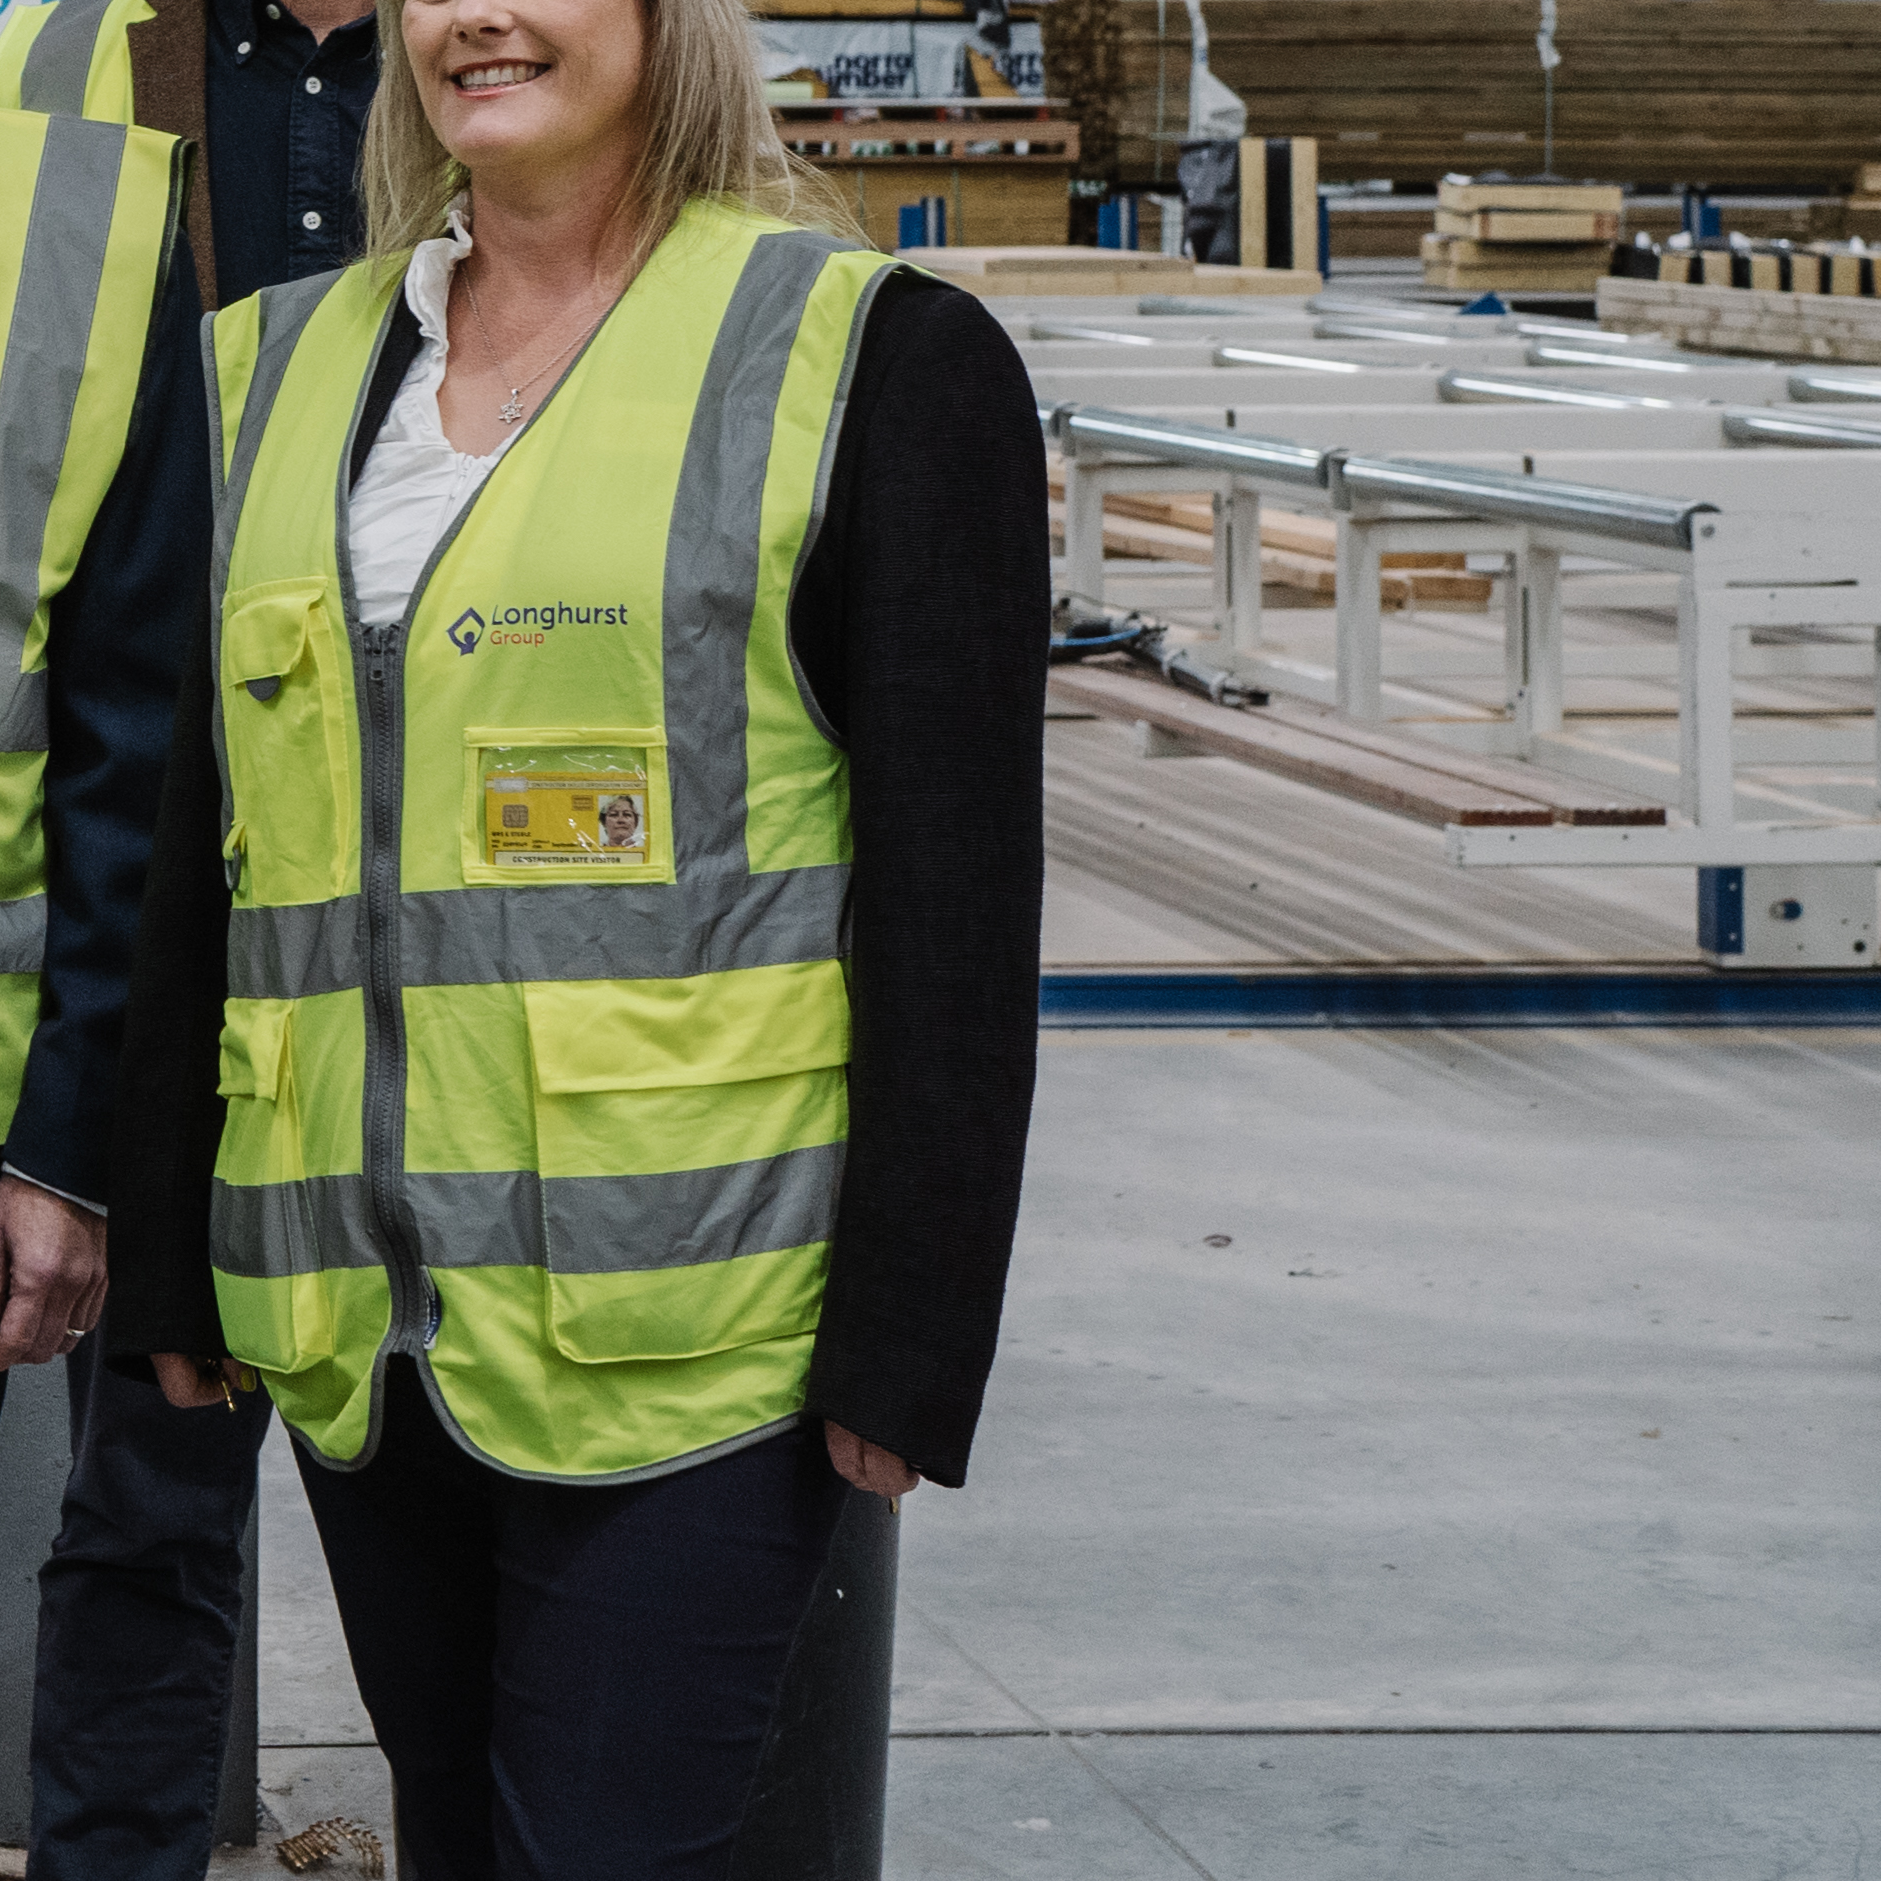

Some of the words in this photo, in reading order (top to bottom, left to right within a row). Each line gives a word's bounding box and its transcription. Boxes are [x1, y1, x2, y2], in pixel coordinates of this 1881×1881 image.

[491, 601, 628, 630] Longhurst
[490, 630, 545, 648] Group
[512, 856, 570, 864] CONSTRUCTION
[572, 856, 588, 864] SITE
[590, 856, 621, 864] VISITOR
